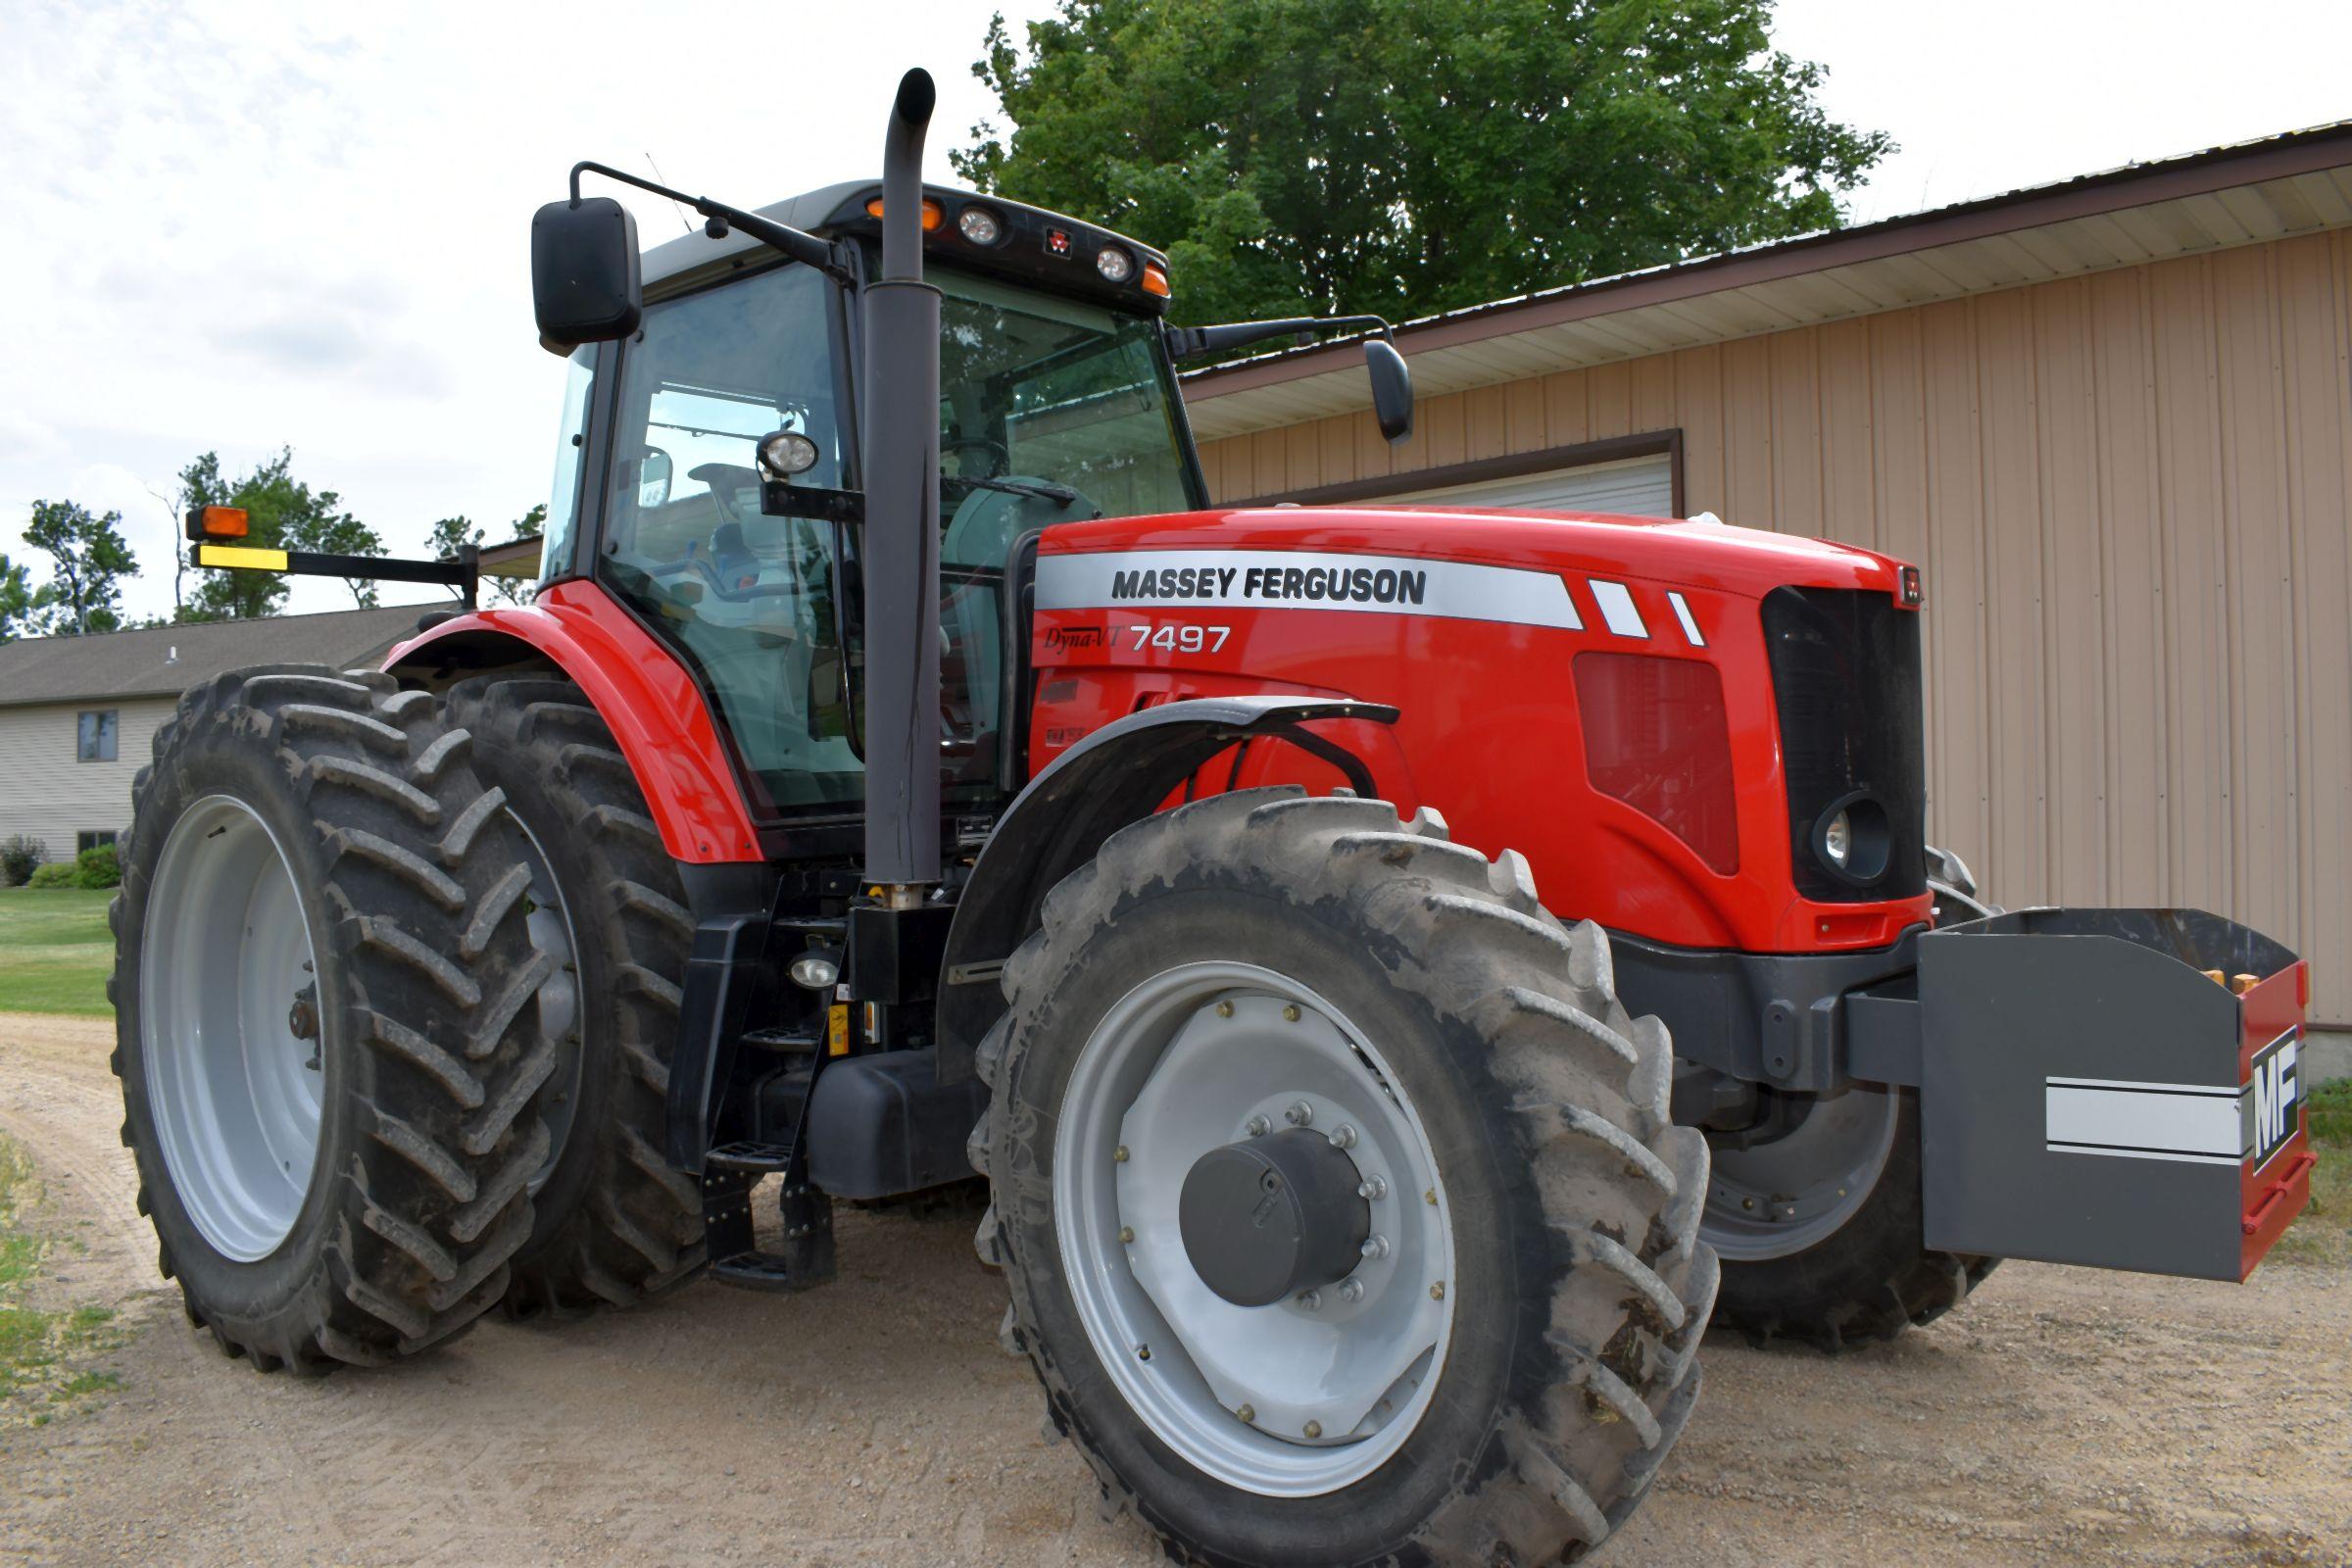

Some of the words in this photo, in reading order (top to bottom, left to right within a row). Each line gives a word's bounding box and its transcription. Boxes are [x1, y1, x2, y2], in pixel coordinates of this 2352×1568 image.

[1111, 567, 1238, 600] MASSEY
[1243, 567, 1427, 605] FERGUSON
[1130, 625, 1231, 654] 7497
[2254, 1039, 2297, 1159] MF
